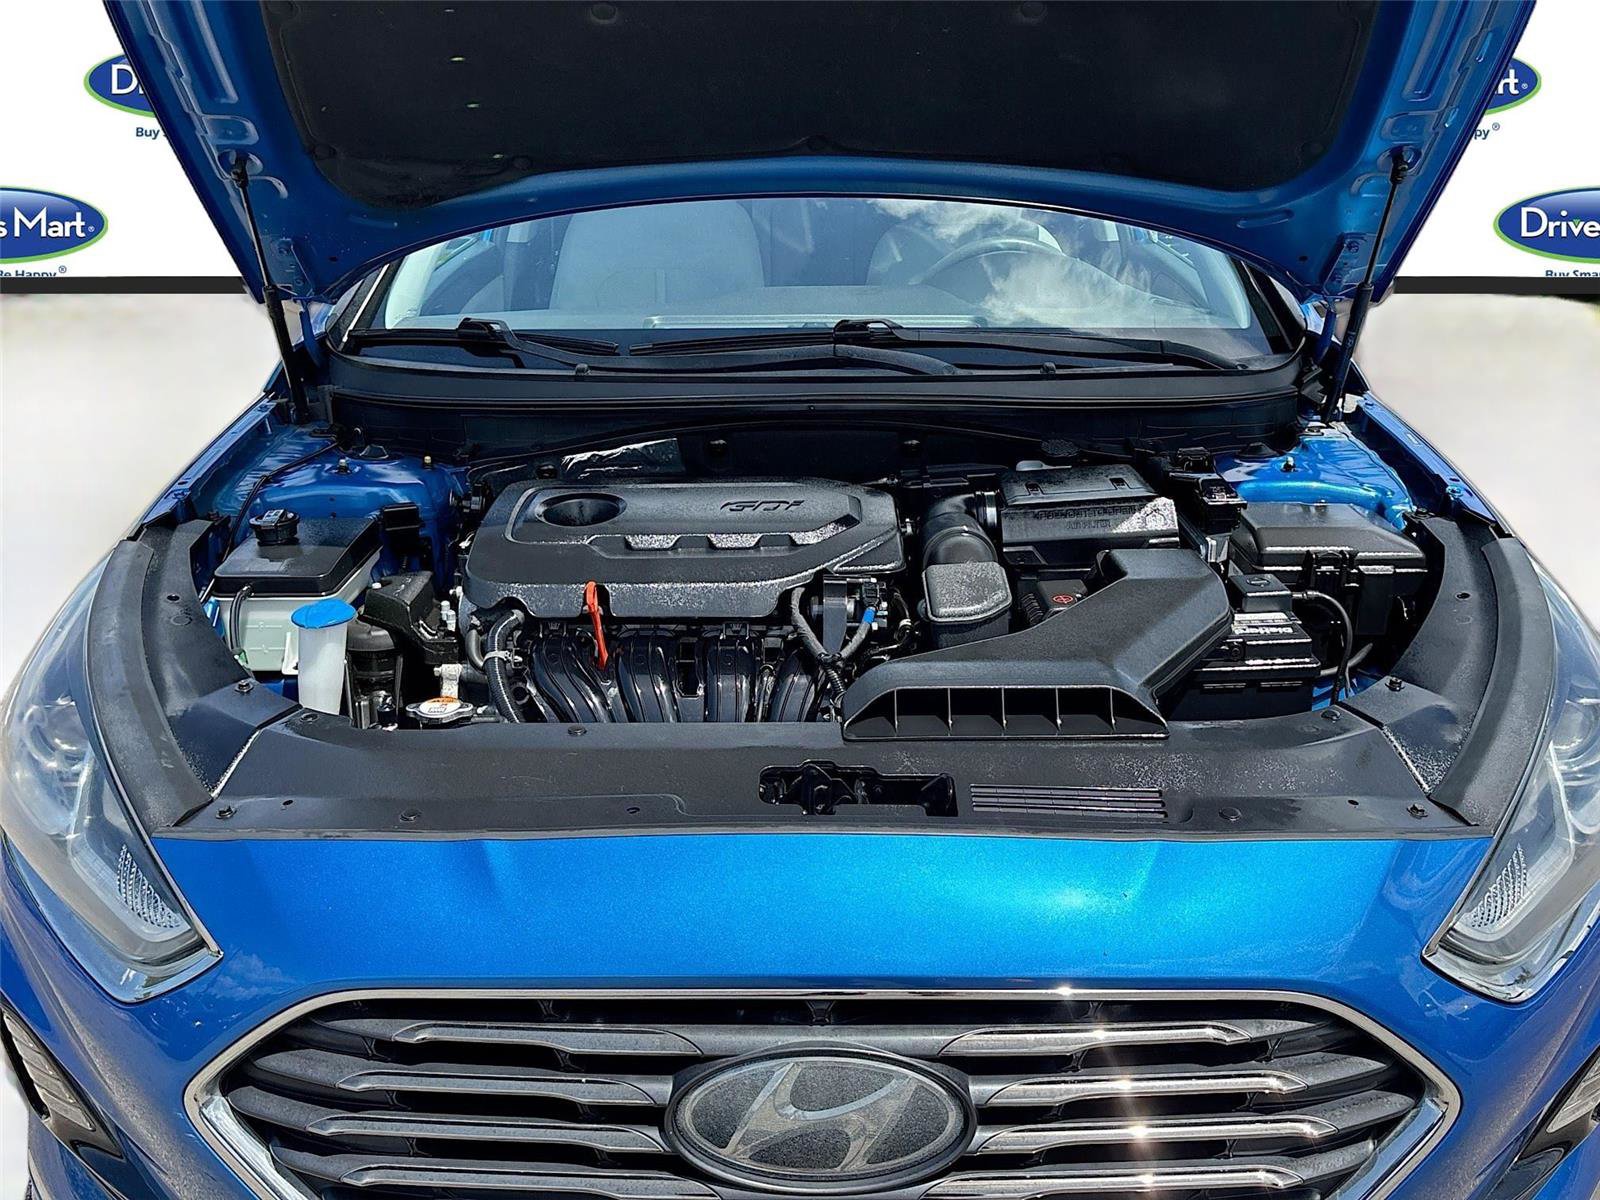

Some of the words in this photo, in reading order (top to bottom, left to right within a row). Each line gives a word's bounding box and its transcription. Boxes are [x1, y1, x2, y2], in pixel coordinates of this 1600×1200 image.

[111, 64, 144, 95] D
[1495, 68, 1519, 95] rt
[136, 126, 160, 140] Buy
[1521, 206, 1600, 238] Drive
